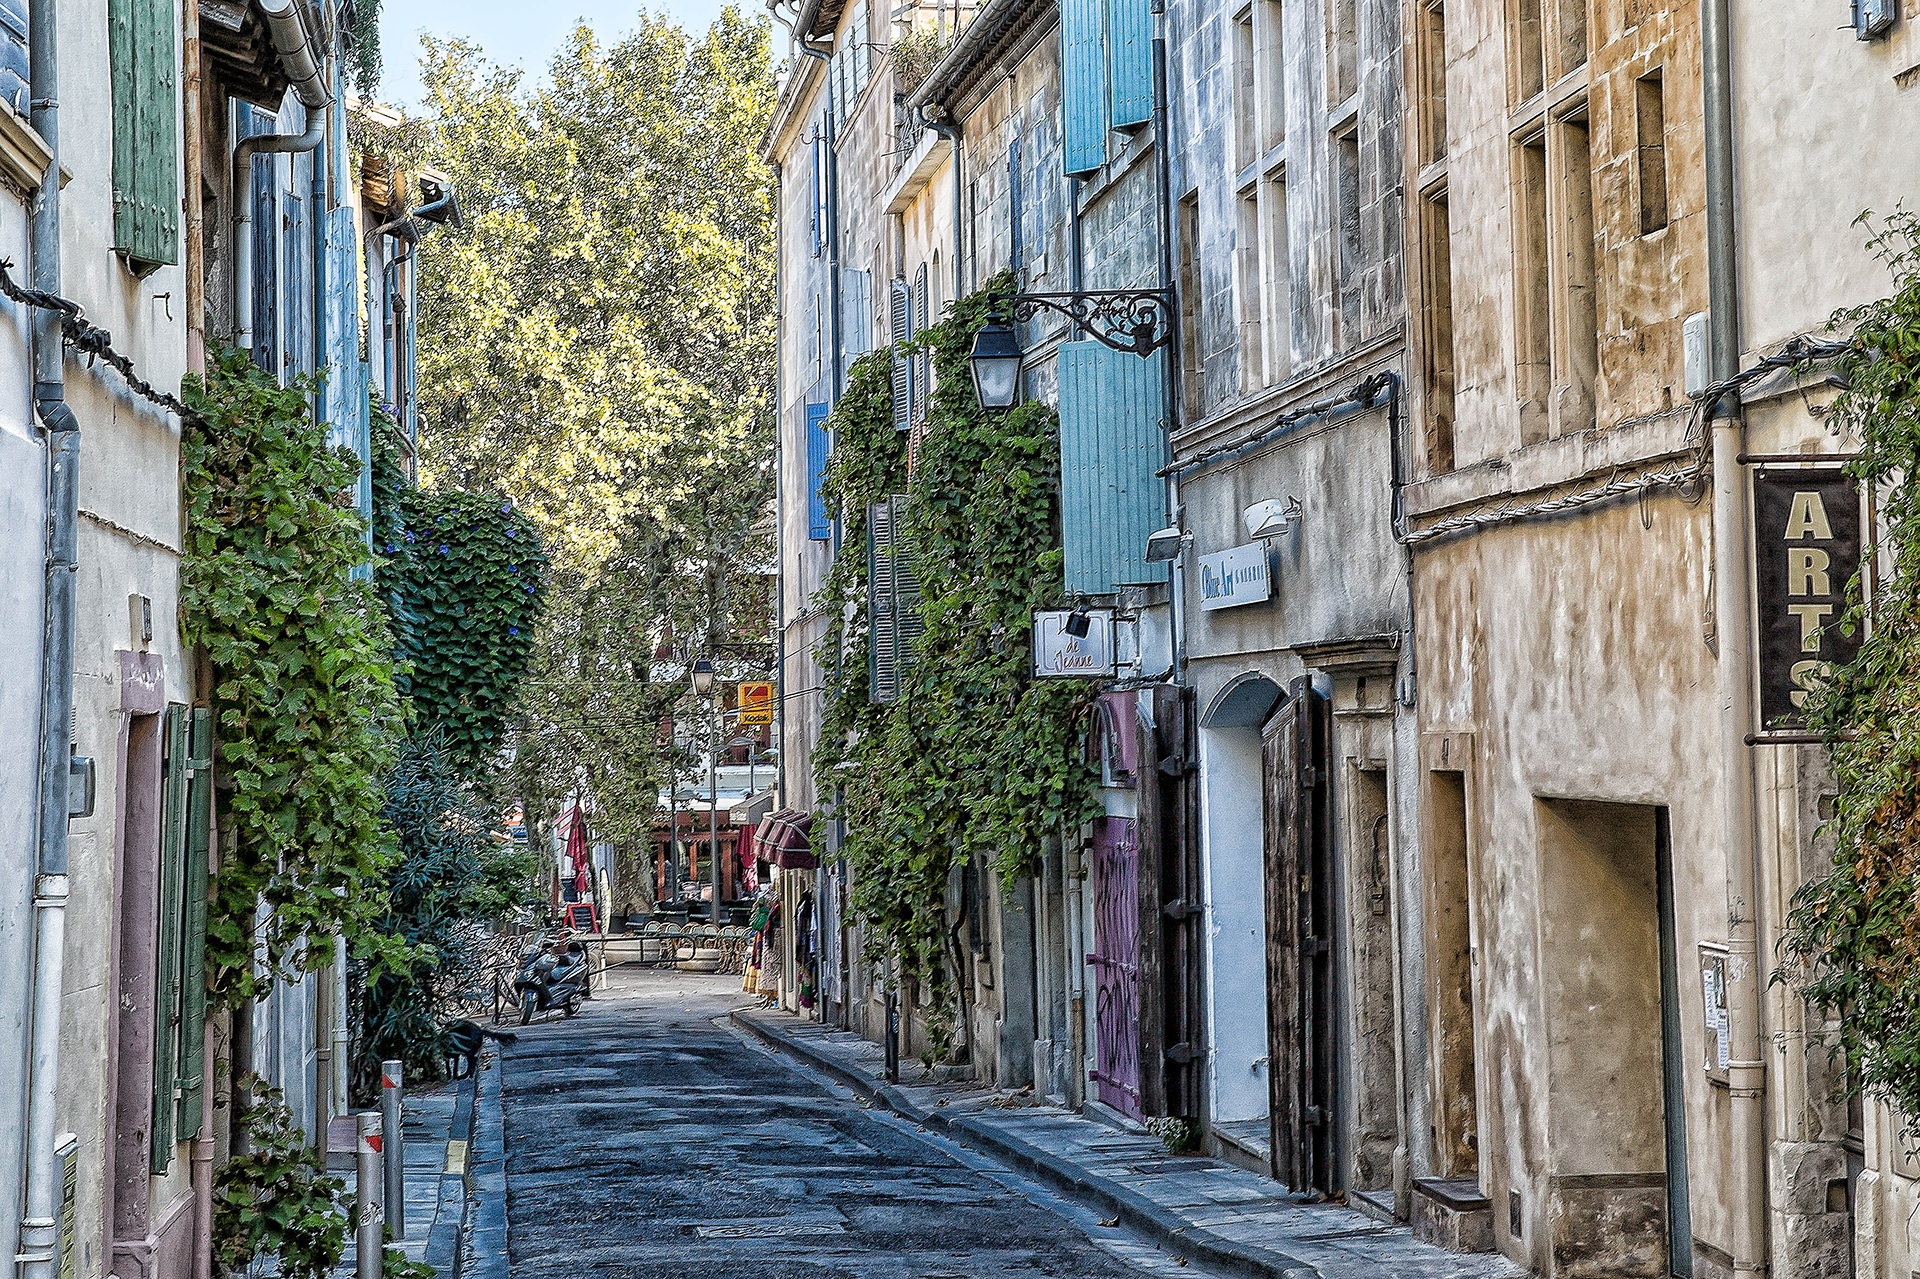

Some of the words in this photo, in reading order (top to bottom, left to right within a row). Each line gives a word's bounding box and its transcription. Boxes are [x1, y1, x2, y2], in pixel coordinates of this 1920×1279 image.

[1783, 490, 1834, 710] ARTS
[1066, 635, 1079, 653] de
[1053, 649, 1093, 673] Jeanne
